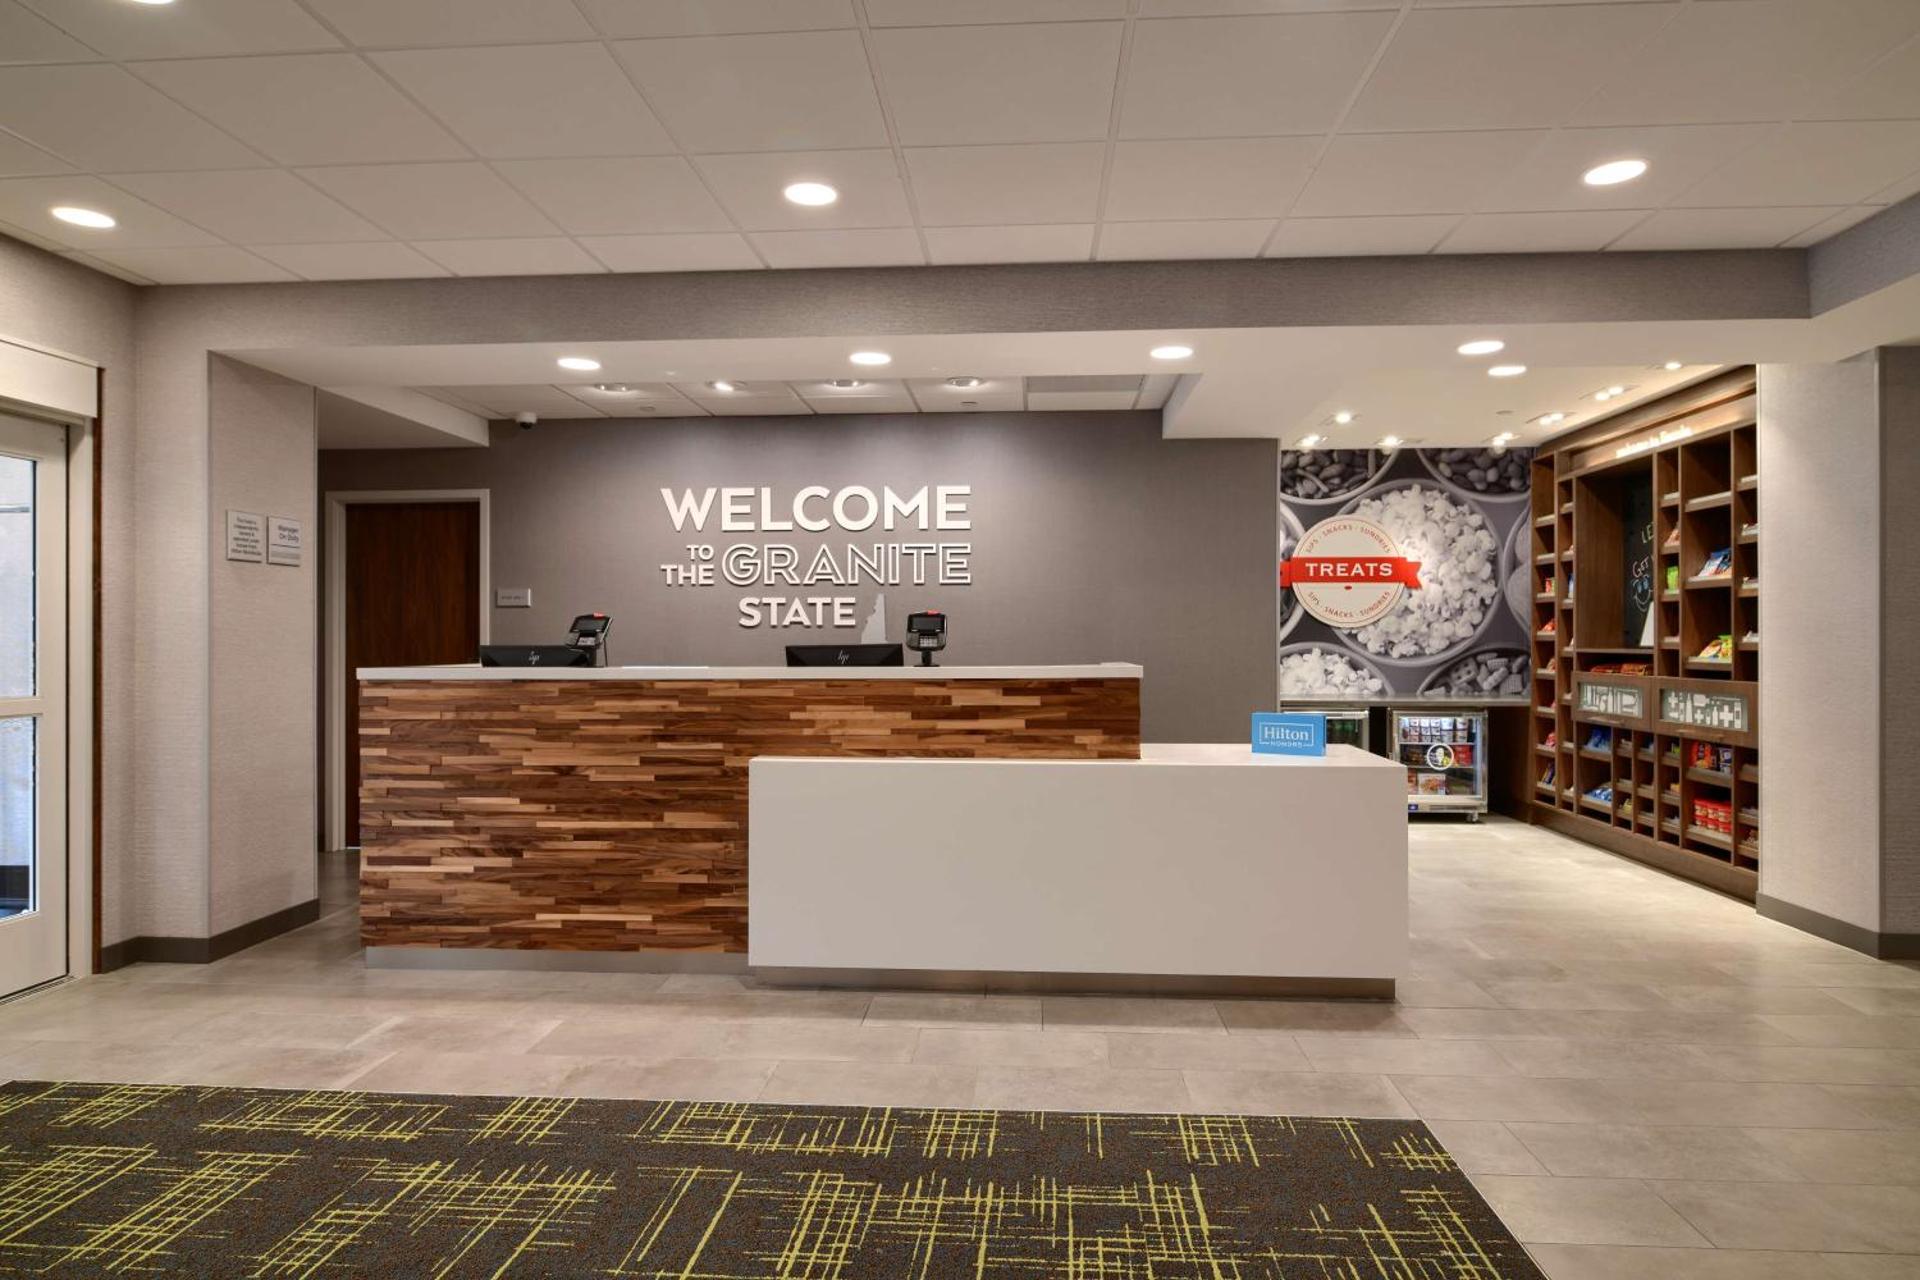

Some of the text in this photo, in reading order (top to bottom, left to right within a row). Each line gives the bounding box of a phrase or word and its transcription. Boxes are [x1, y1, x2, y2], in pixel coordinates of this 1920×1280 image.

[660, 485, 972, 532] WELCOME
[686, 543, 715, 562] TO
[1322, 523, 1353, 536] SNACKS
[1360, 526, 1391, 554] SUNDRIES
[660, 542, 972, 587] THE GRANITE
[1305, 561, 1393, 577] TREATS
[738, 596, 857, 628] STATE
[1324, 605, 1354, 619] SNACKS
[1360, 590, 1391, 617] SUNDRIES
[1264, 726, 1310, 741] Hilton
